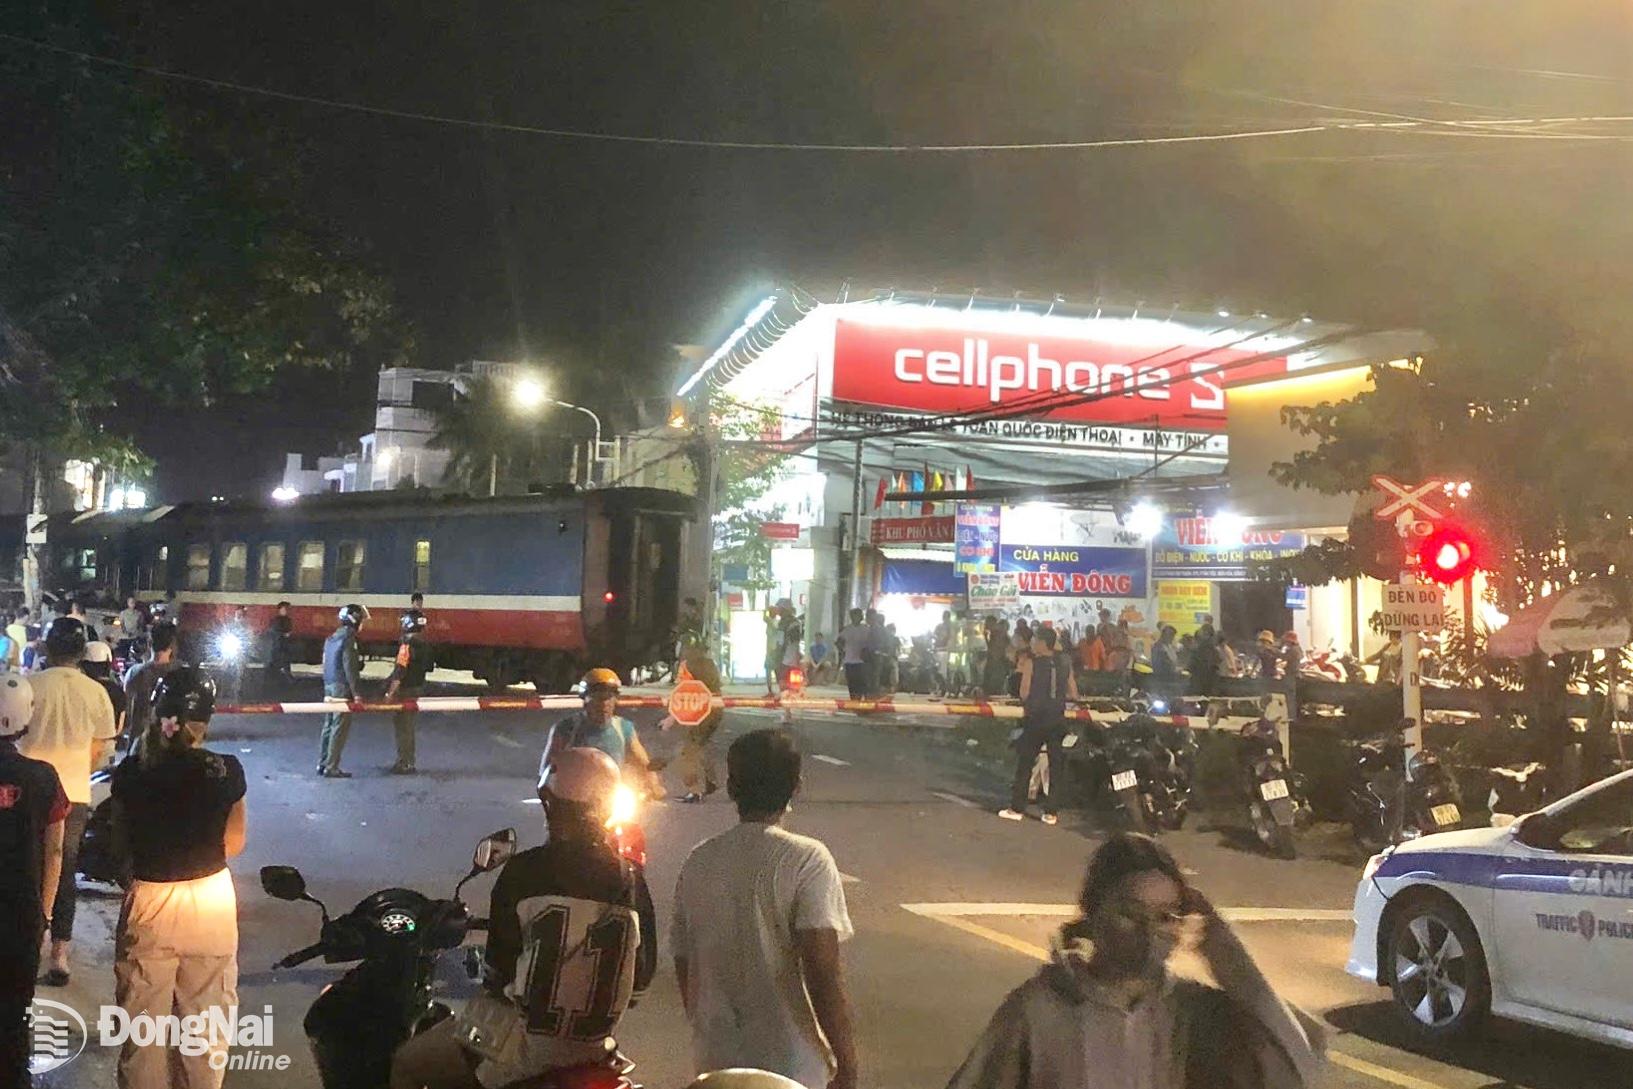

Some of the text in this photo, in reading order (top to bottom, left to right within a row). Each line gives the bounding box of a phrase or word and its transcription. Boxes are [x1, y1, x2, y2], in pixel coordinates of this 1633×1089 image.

[894, 338, 1171, 402] cellphone
[1013, 545, 1079, 562] CỬA HÀNG
[1018, 563, 1133, 594] VIỄN ĐÔNG
[672, 692, 708, 711] STOP
[526, 904, 632, 1040] 11
